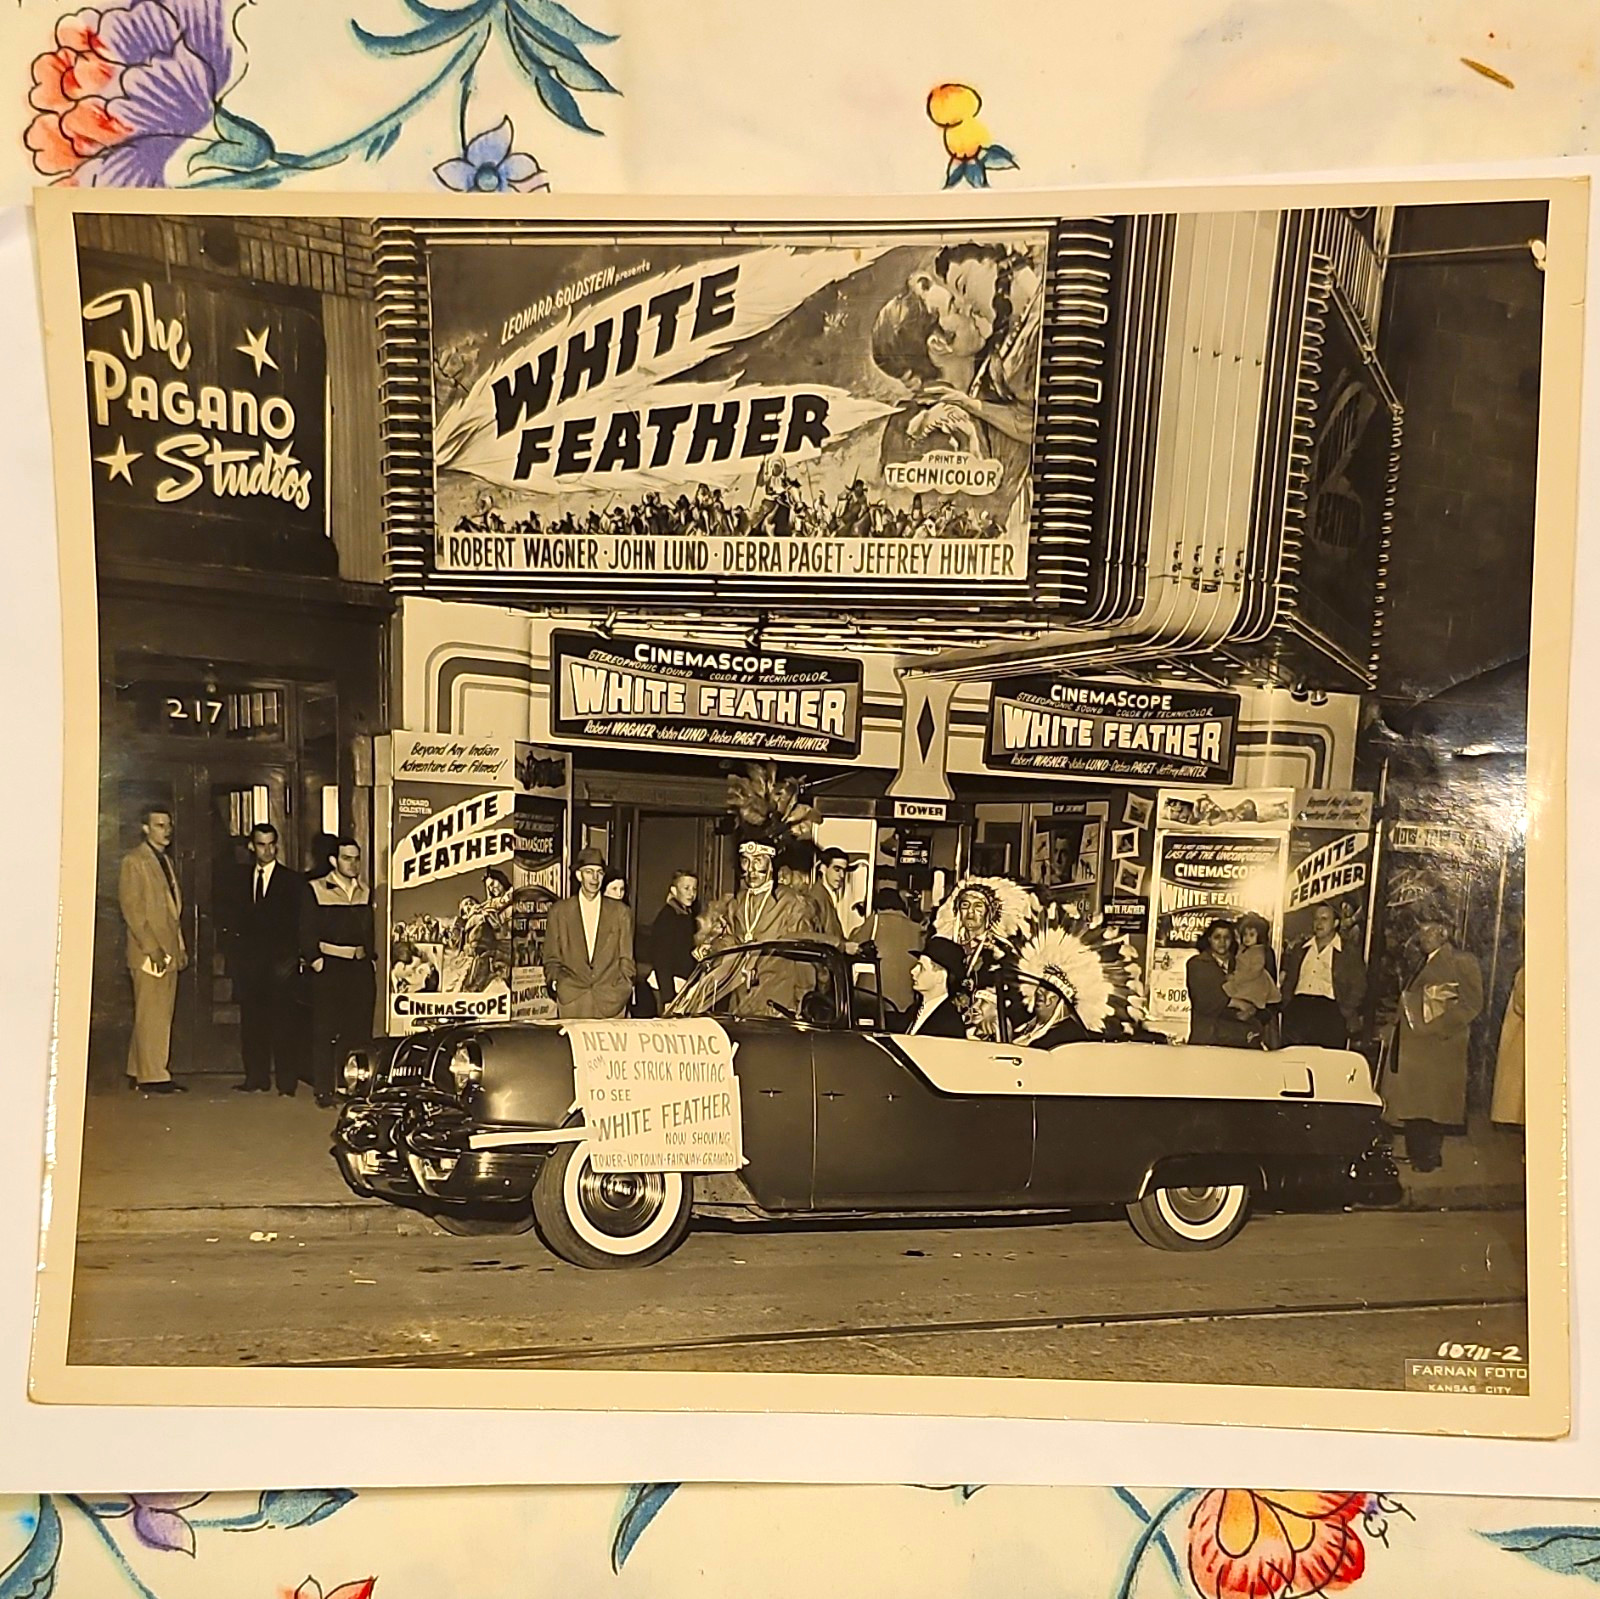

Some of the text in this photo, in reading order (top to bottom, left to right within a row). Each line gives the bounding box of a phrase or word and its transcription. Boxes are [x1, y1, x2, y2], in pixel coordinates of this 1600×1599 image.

[501, 295, 553, 345] LEONARD
[555, 266, 615, 308] GOLDSTEIN
[83, 282, 192, 371] The
[491, 264, 740, 440] WHITE
[513, 393, 832, 481] FEATHER
[155, 433, 313, 511] Studios
[928, 455, 968, 465] PRINT BY
[887, 467, 997, 487] TECHNICOLOR
[450, 536, 1015, 576] ROBERT WAGNER JOHN LUND DEBRA PAGET JEFFREY HUNTER
[588, 649, 832, 683] STEREOPHONIC SOUND COLOR BY TECHNICOLOR
[634, 643, 788, 675] CINEMASCOPE
[166, 698, 223, 725] 217
[570, 662, 845, 736] WHITE FEATHER
[1016, 692, 1074, 711] STEREOPHONIC
[1075, 704, 1103, 714] SOUND
[1116, 709, 1141, 717] COLOR
[1156, 707, 1214, 719] TECHNICOLOR
[1051, 684, 1172, 710] CINEMASCOPE
[411, 742, 500, 757] Beyond Any Indian
[584, 720, 611, 735] Robert
[612, 722, 655, 739] WAGNER
[678, 728, 707, 742] LUND
[709, 730, 732, 745] Debra
[732, 732, 763, 746] PAGET
[793, 736, 830, 752] HUNTER
[1002, 704, 1222, 763] WHITE FEATHER
[399, 759, 447, 773] Adventure
[448, 761, 467, 773] Ever
[1085, 758, 1108, 771] LUND
[411, 794, 498, 854] WHITE
[899, 803, 944, 817] TOWER
[403, 832, 514, 883] FEATHER
[1297, 835, 1355, 884] WHITE
[1160, 882, 1208, 913] WHITE
[1290, 866, 1364, 908] FEATHER
[394, 994, 508, 1015] CINEMASCOPE
[582, 1031, 721, 1055] NEW PONTIAC
[606, 1060, 627, 1080] JOE
[634, 1061, 673, 1081] STRICK
[679, 1062, 725, 1083] PONTIAC
[590, 1089, 631, 1101] TO SEE
[592, 1092, 731, 1142] WHITE FEATHER
[665, 1132, 730, 1145] NOW SHOWING
